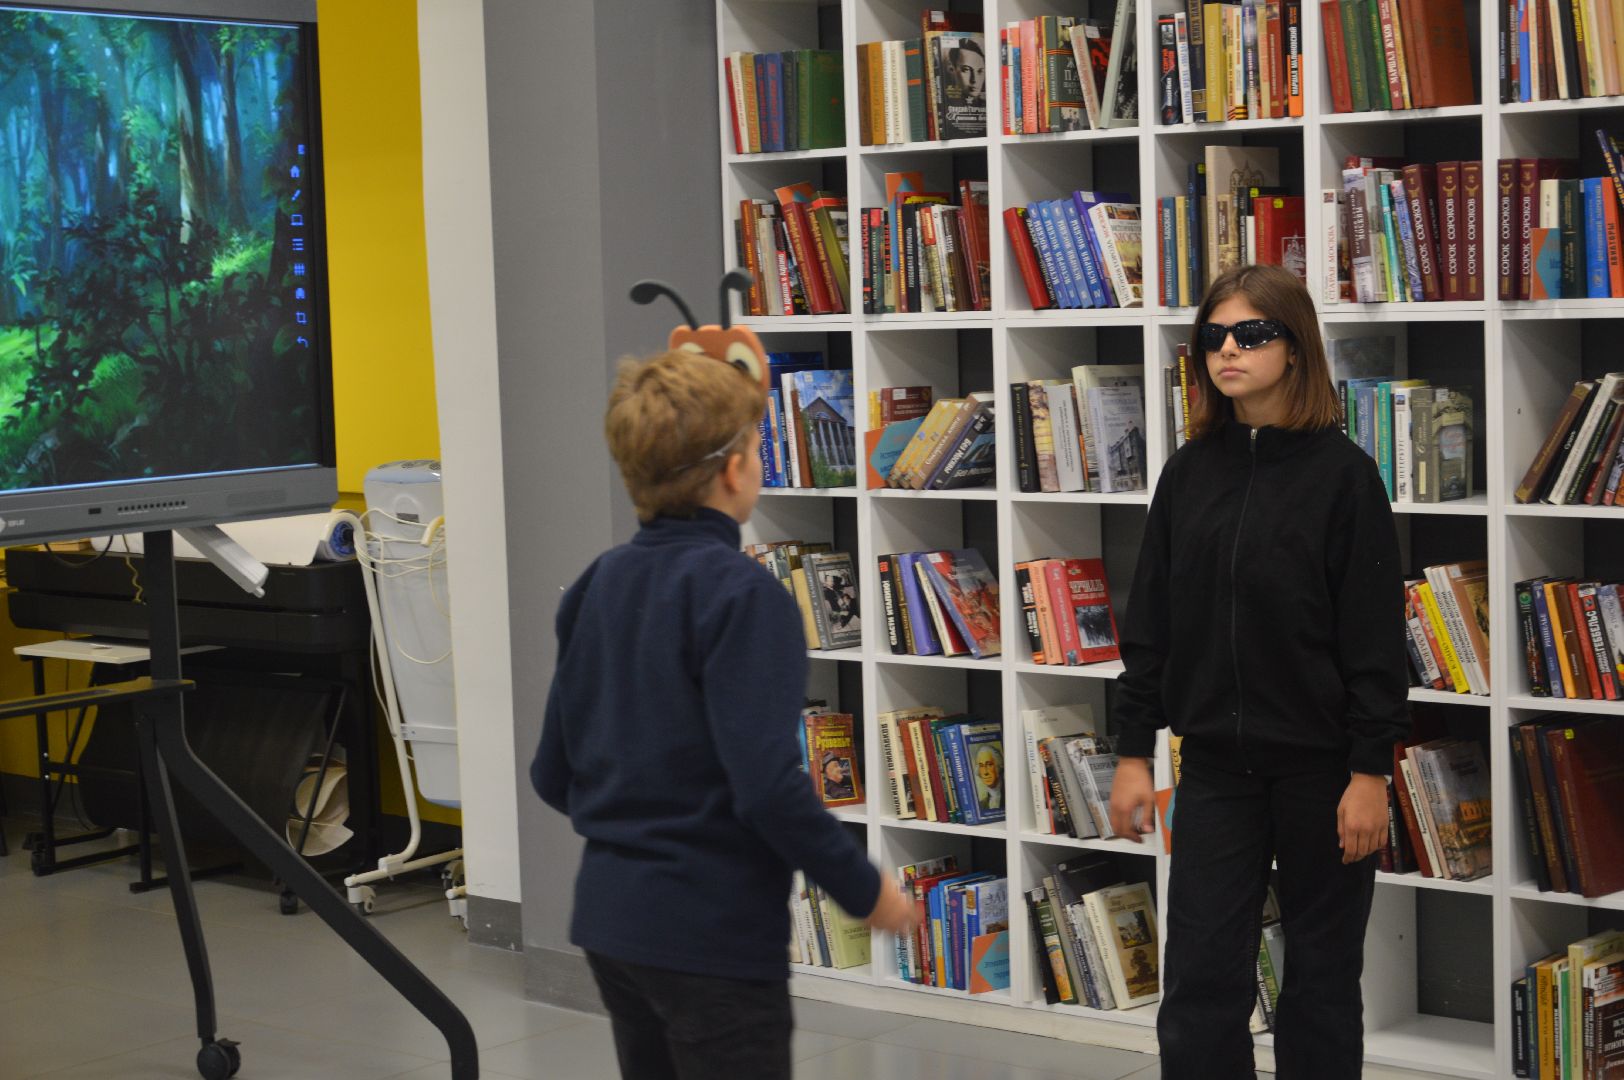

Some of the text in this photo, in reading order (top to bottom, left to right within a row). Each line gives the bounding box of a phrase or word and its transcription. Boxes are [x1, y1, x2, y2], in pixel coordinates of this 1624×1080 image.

[1288, 26, 1297, 68] МАЛИНОВСКИЙ
[1381, 23, 1399, 83] МАРШАЛ ЖУКОВ
[1033, 219, 1048, 250] МОСКВЫ
[1043, 219, 1060, 250] МОСКВЫ
[1070, 218, 1086, 249] МОСКВЫ
[1411, 198, 1431, 274] СОРОК СОРОКОВ
[1445, 198, 1457, 274] СОРОК СОРОКОВ
[1466, 198, 1475, 274] СОРОК СОРОКОВ
[1501, 196, 1509, 274] СОРОК СОРОКОВ
[1521, 196, 1531, 274] СОРОК СОРОКОВ
[1606, 222, 1618, 265] АВИАТОРЫ
[881, 580, 897, 645] СПАСТИ ИТАЛИЮ!
[1538, 612, 1552, 647] РИШЕЛЬЕ
[1586, 609, 1604, 652] ГЕББЕЛЬС
[1411, 624, 1435, 672] КАЗАНОВА
[949, 741, 966, 782] ВАШИНГТОН
